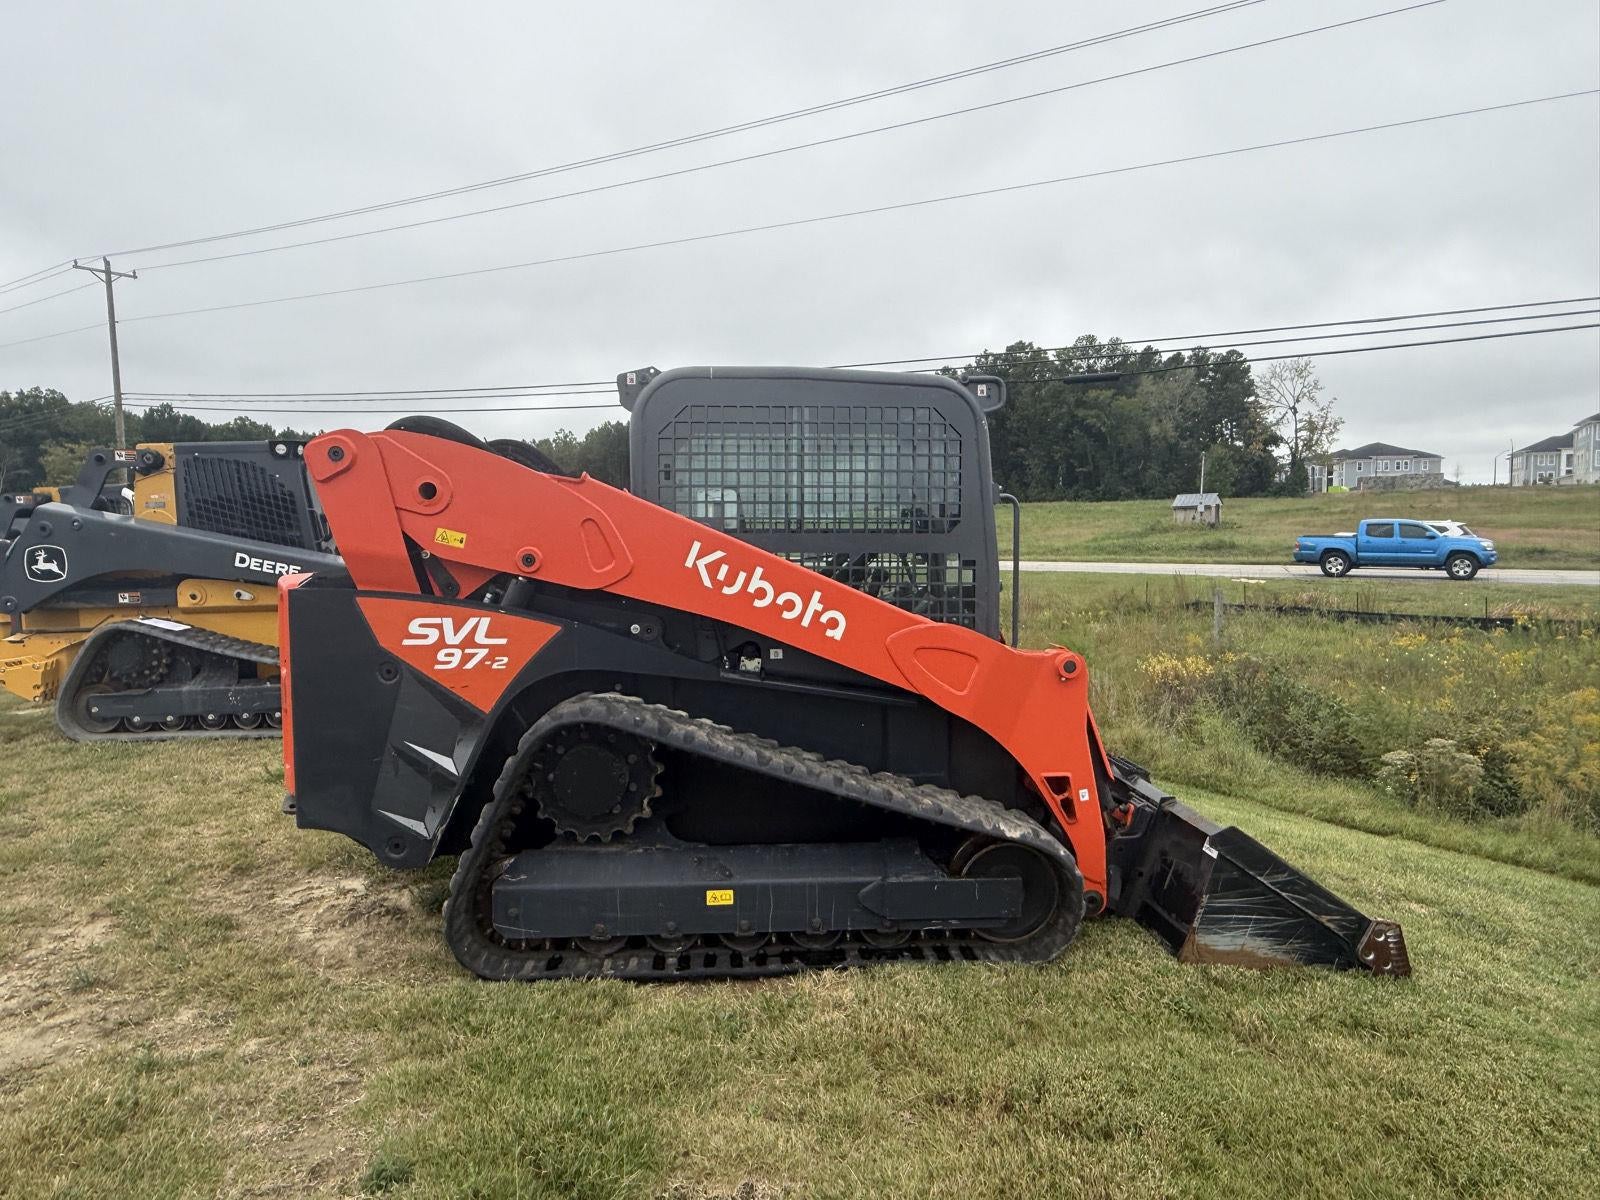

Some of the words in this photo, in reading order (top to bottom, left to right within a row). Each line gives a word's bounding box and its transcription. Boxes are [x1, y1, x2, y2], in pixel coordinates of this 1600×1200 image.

[684, 540, 847, 641] Kubota
[401, 616, 508, 646] SVL
[433, 647, 509, 670] 97-2
